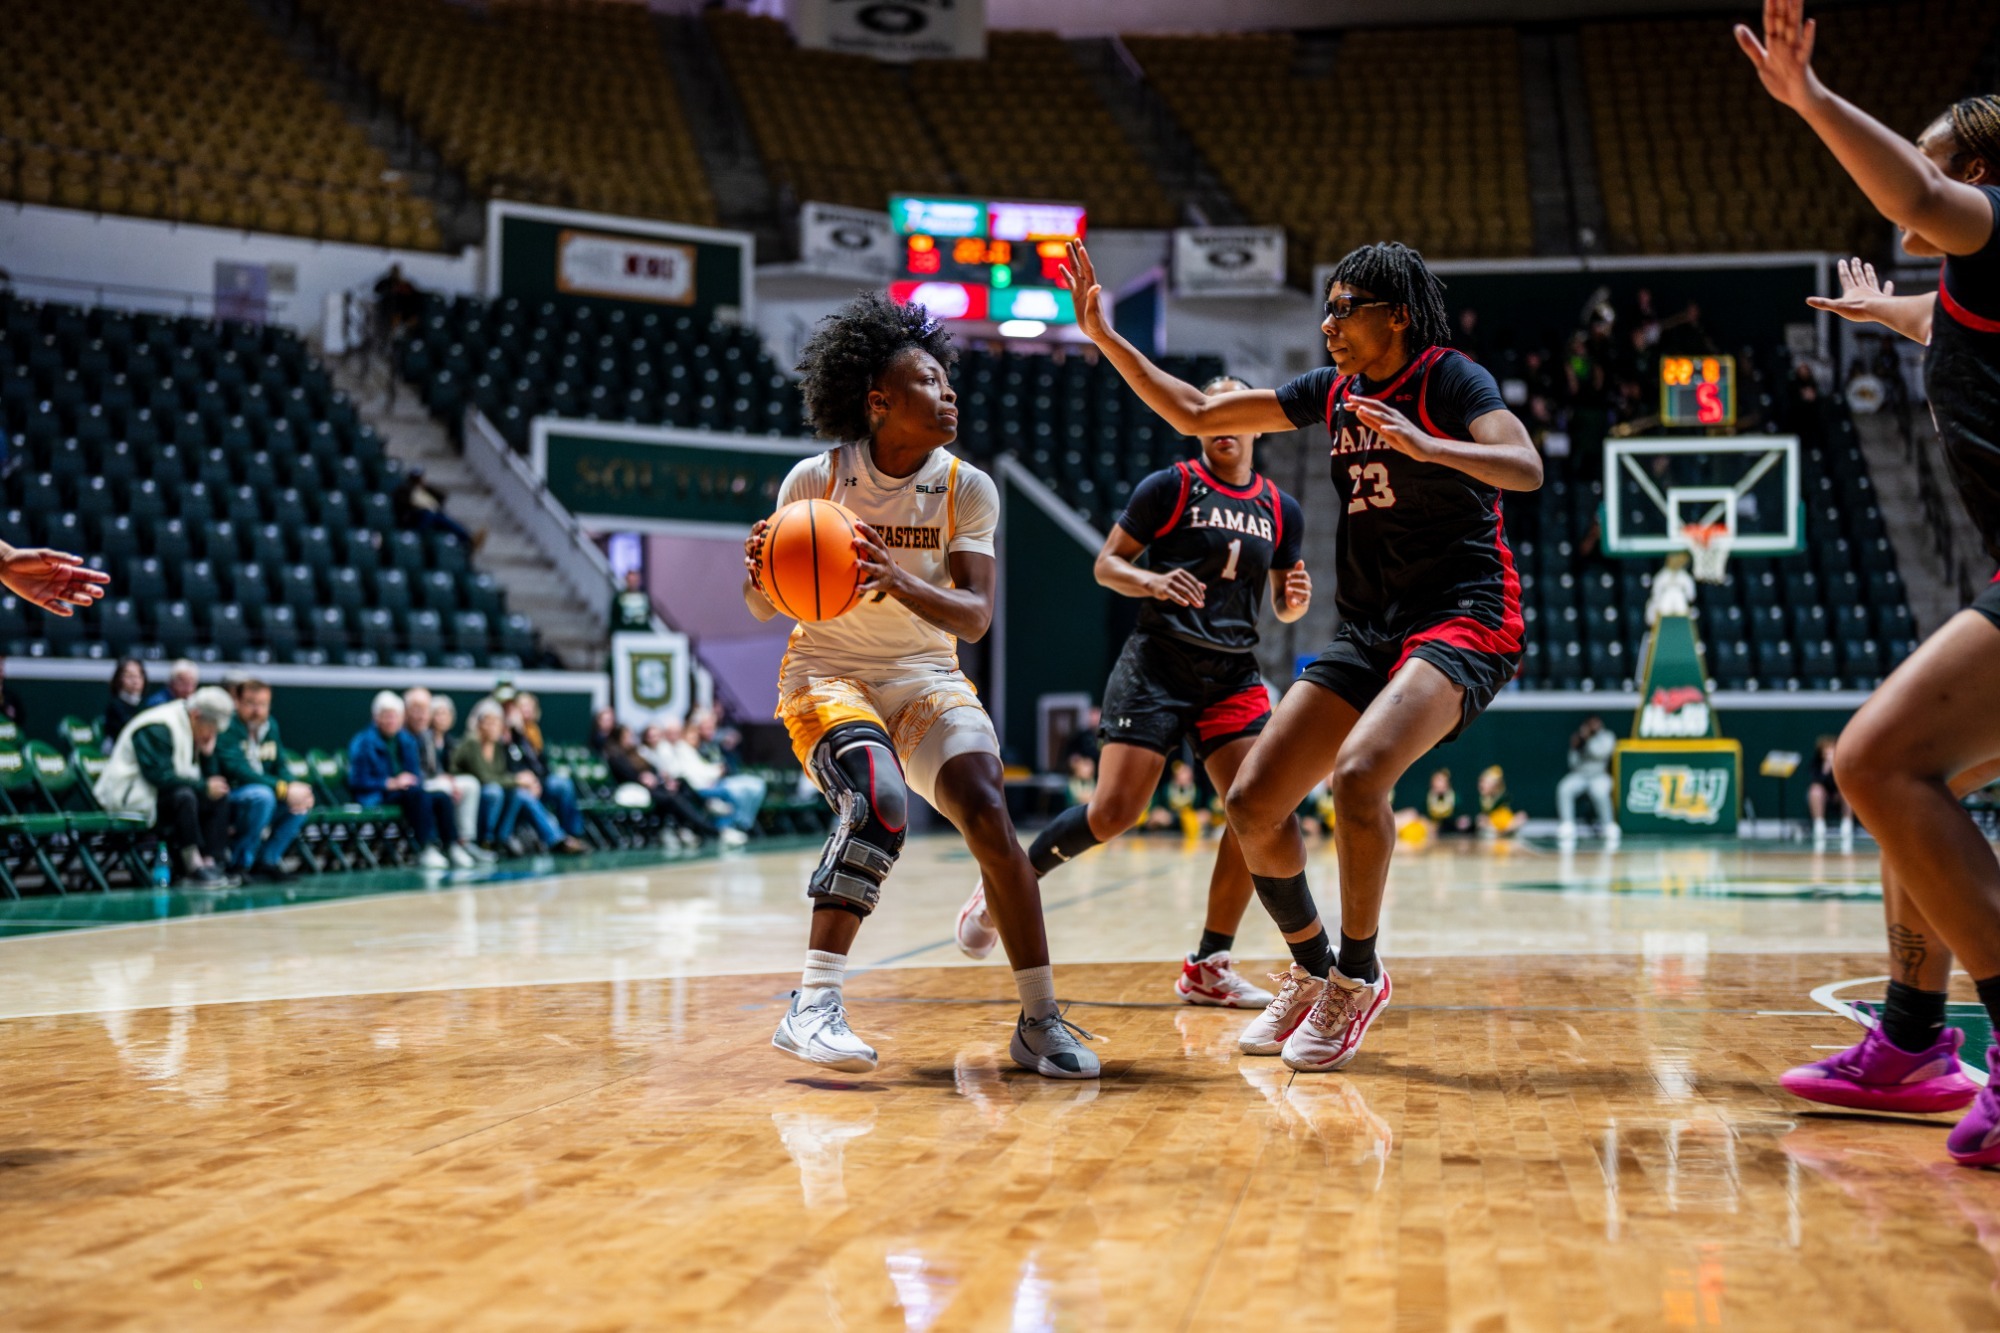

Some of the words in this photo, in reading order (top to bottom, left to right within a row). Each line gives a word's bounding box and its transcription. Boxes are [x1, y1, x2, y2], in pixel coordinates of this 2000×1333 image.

[1330, 425, 1391, 456] AMA
[1347, 462, 1397, 514] 23
[868, 523, 941, 550] EASTERN
[1191, 506, 1273, 542] LAMAR
[1221, 538, 1241, 580] 1
